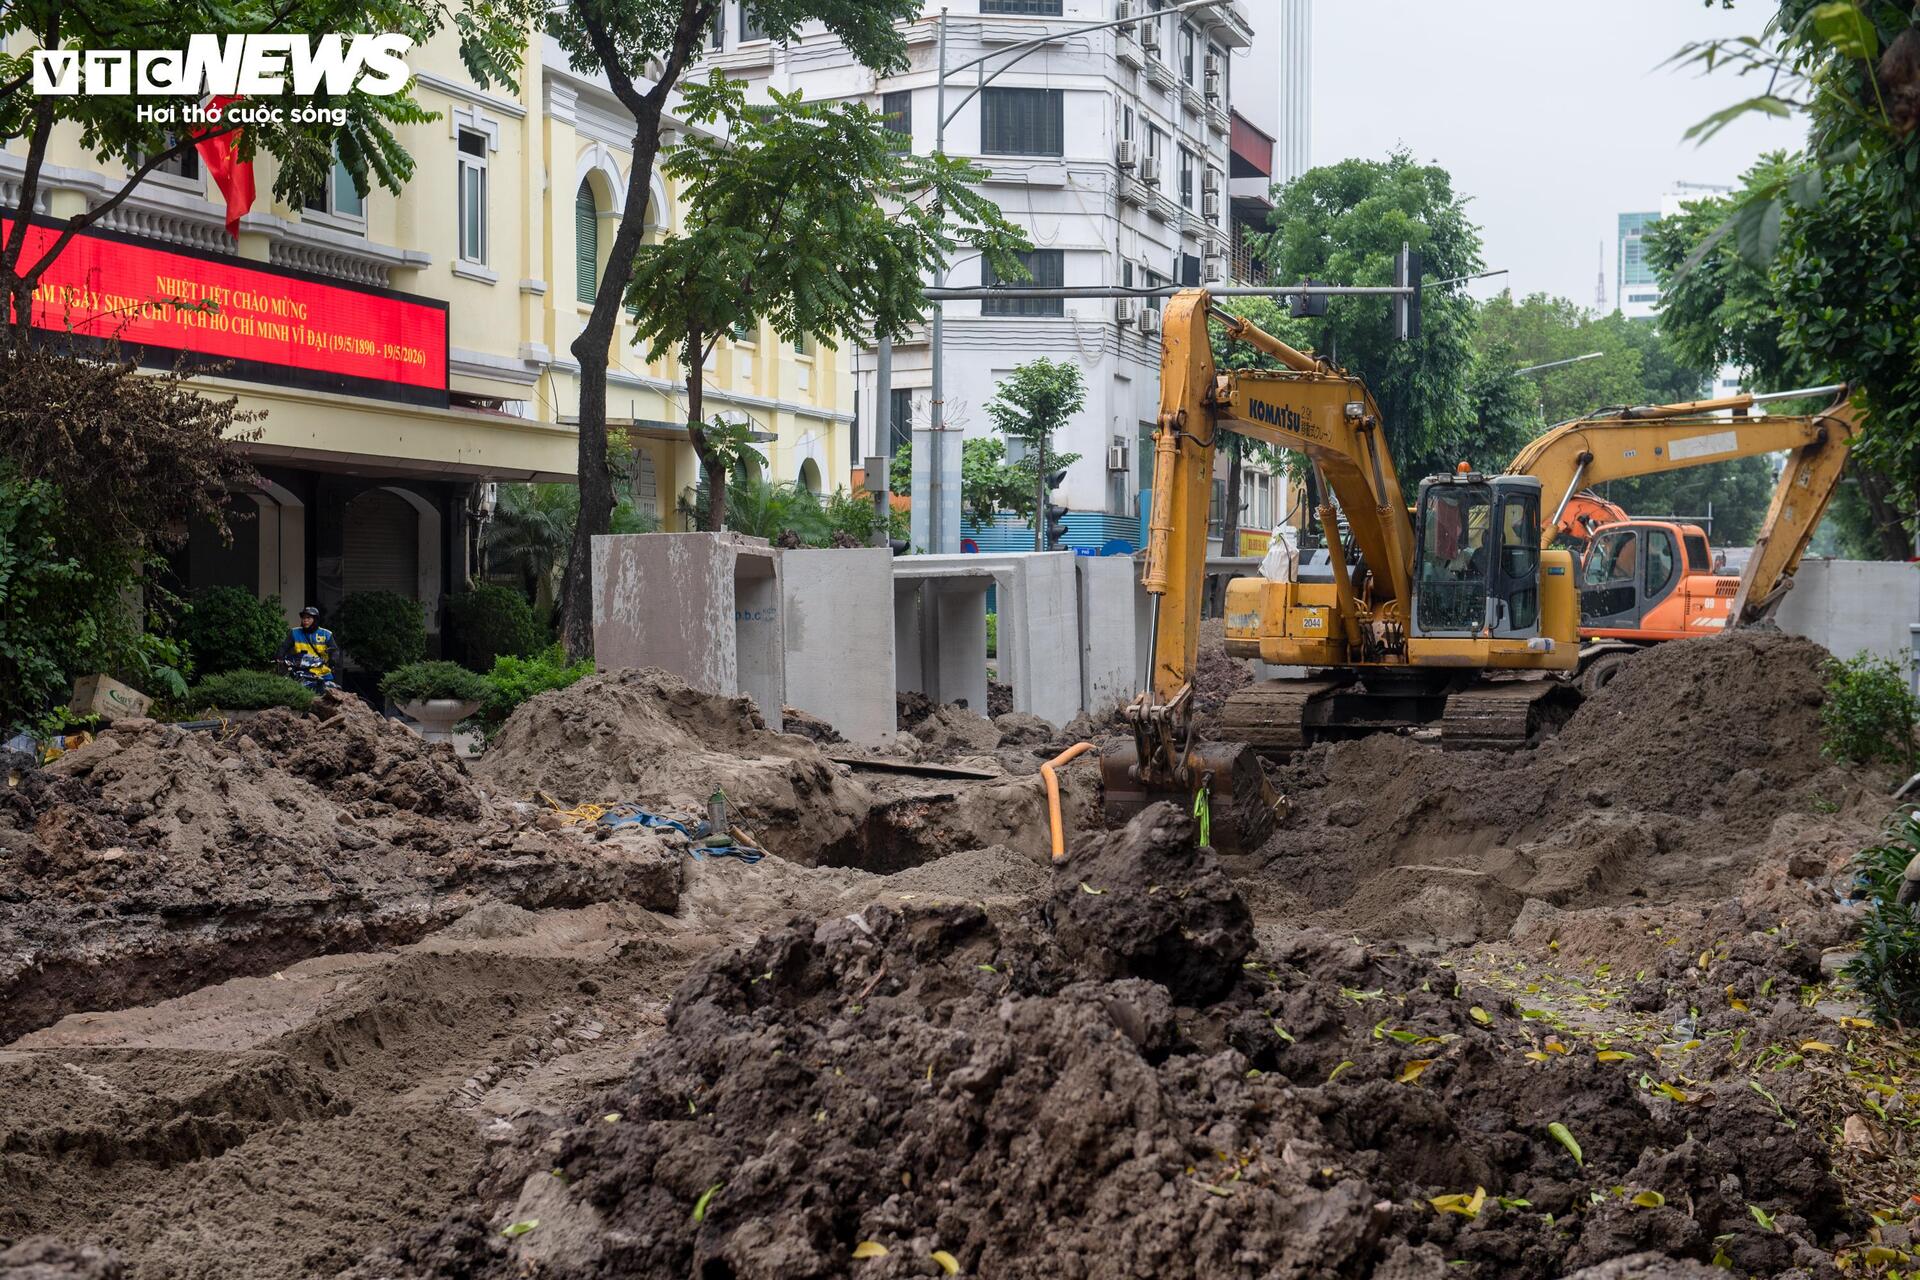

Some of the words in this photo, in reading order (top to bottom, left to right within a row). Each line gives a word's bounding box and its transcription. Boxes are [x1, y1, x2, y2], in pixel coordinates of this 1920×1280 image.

[156, 275, 198, 302] NHIỆT
[233, 289, 268, 313] CHÀO
[271, 295, 307, 321] MỪNG
[59, 285, 101, 310] NGÀY
[105, 294, 139, 317] SINH
[176, 306, 207, 330] TỊCH
[210, 310, 228, 332] HỒ
[231, 315, 255, 337] CHÍ
[257, 321, 289, 342] MINH
[292, 324, 304, 345] VĨ
[307, 332, 327, 351] ĐẠI
[329, 335, 375, 357] (19/5/1890
[383, 344, 427, 368] 19/5/2026)
[1249, 398, 1301, 433] KOMATSU
[1303, 619, 1321, 628] 2044
